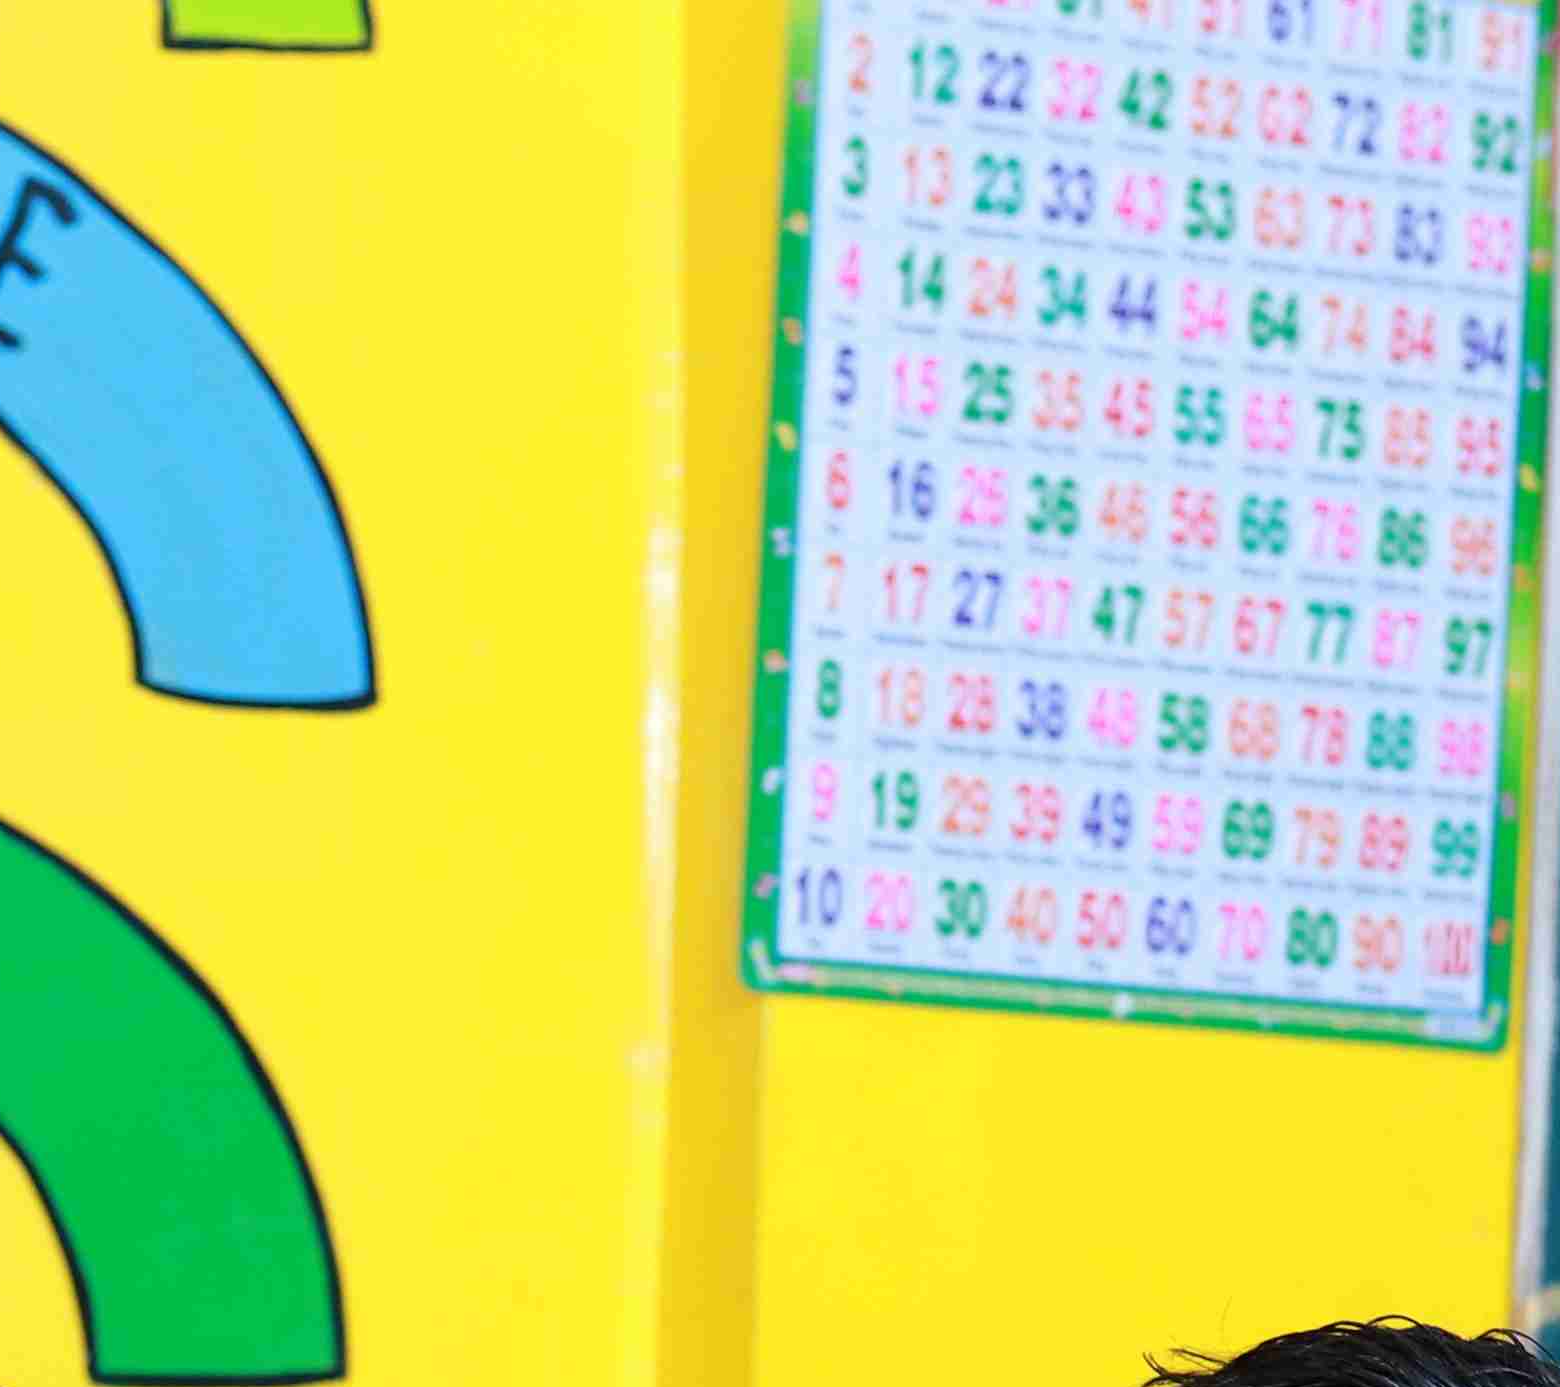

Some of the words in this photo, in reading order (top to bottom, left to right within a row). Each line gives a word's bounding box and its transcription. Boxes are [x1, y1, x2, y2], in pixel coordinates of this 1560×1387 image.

[846, 30, 872, 94] 2
[908, 41, 960, 106] 12
[977, 50, 1031, 113] 22
[1047, 57, 1104, 125] 32
[1118, 70, 1172, 132] 42
[1188, 70, 1243, 144] 52
[1257, 80, 1312, 149] 62
[1331, 91, 1381, 158] 72
[1471, 110, 1524, 176] 92
[841, 134, 869, 199] 3
[897, 144, 955, 209] 13
[972, 152, 1024, 218] 23
[1042, 160, 1096, 227] 33
[1112, 175, 1168, 236] 43
[1184, 177, 1236, 242] 53
[1326, 192, 1376, 261] 73
[1393, 200, 1445, 267] 83
[1468, 211, 1516, 275] 93
[834, 235, 863, 304] 4
[897, 250, 946, 311] 14
[966, 256, 1019, 320] 24
[1037, 264, 1088, 328] 34
[1108, 275, 1158, 332] 44
[1180, 279, 1231, 342] 54
[1248, 289, 1300, 352] 64
[1318, 293, 1370, 353] 74
[1386, 304, 1439, 365] 84
[1462, 314, 1510, 376] 94
[830, 342, 856, 406] 5
[895, 352, 944, 418] 15
[961, 360, 1013, 426] 25
[1031, 368, 1087, 436] 35
[1103, 378, 1153, 440] 45
[1172, 384, 1225, 448] 55
[1242, 391, 1296, 457] 65
[1315, 397, 1365, 462] 75
[1382, 404, 1436, 472] 85
[823, 449, 850, 513] 6
[888, 460, 936, 523] 16
[1025, 473, 1080, 540] 36
[1094, 480, 1151, 545] 46
[1168, 485, 1220, 550] 56
[1238, 494, 1290, 557] 66
[1312, 497, 1360, 564] 76
[1376, 504, 1429, 571] 86
[1450, 518, 1500, 580] 96
[823, 552, 846, 615] 7
[880, 560, 932, 623] 17
[951, 568, 1005, 629] 27
[1023, 575, 1073, 640] 37
[1092, 584, 1145, 643] 47
[1161, 587, 1216, 648] 57
[1232, 595, 1288, 656] 67
[1304, 599, 1357, 664] 77
[1368, 608, 1424, 672] 87
[1444, 616, 1496, 676] 97
[815, 657, 843, 721] 8
[875, 662, 927, 731] 18
[1016, 678, 1068, 744] 38
[1087, 688, 1137, 750] 48
[1158, 692, 1209, 756] 58
[1224, 698, 1280, 765] 68
[1300, 703, 1351, 768] 78
[1364, 709, 1416, 773] 88
[811, 761, 838, 824] 9
[872, 769, 920, 832] 19
[939, 773, 992, 841] 29
[1009, 783, 1065, 848] 39
[1080, 790, 1133, 851] 49
[1151, 792, 1205, 856] 59
[1222, 800, 1275, 862] 69
[1291, 802, 1344, 872] 79
[1357, 808, 1411, 874] 89
[1433, 817, 1482, 878] 99
[795, 865, 843, 928] 10
[864, 870, 913, 935] 20
[935, 878, 988, 942] 30
[1006, 884, 1057, 946] 40
[1072, 888, 1128, 952] 50
[1144, 896, 1196, 960] 60
[1216, 900, 1270, 964] 70
[1285, 906, 1340, 971] 80
[1352, 911, 1407, 976] 90
